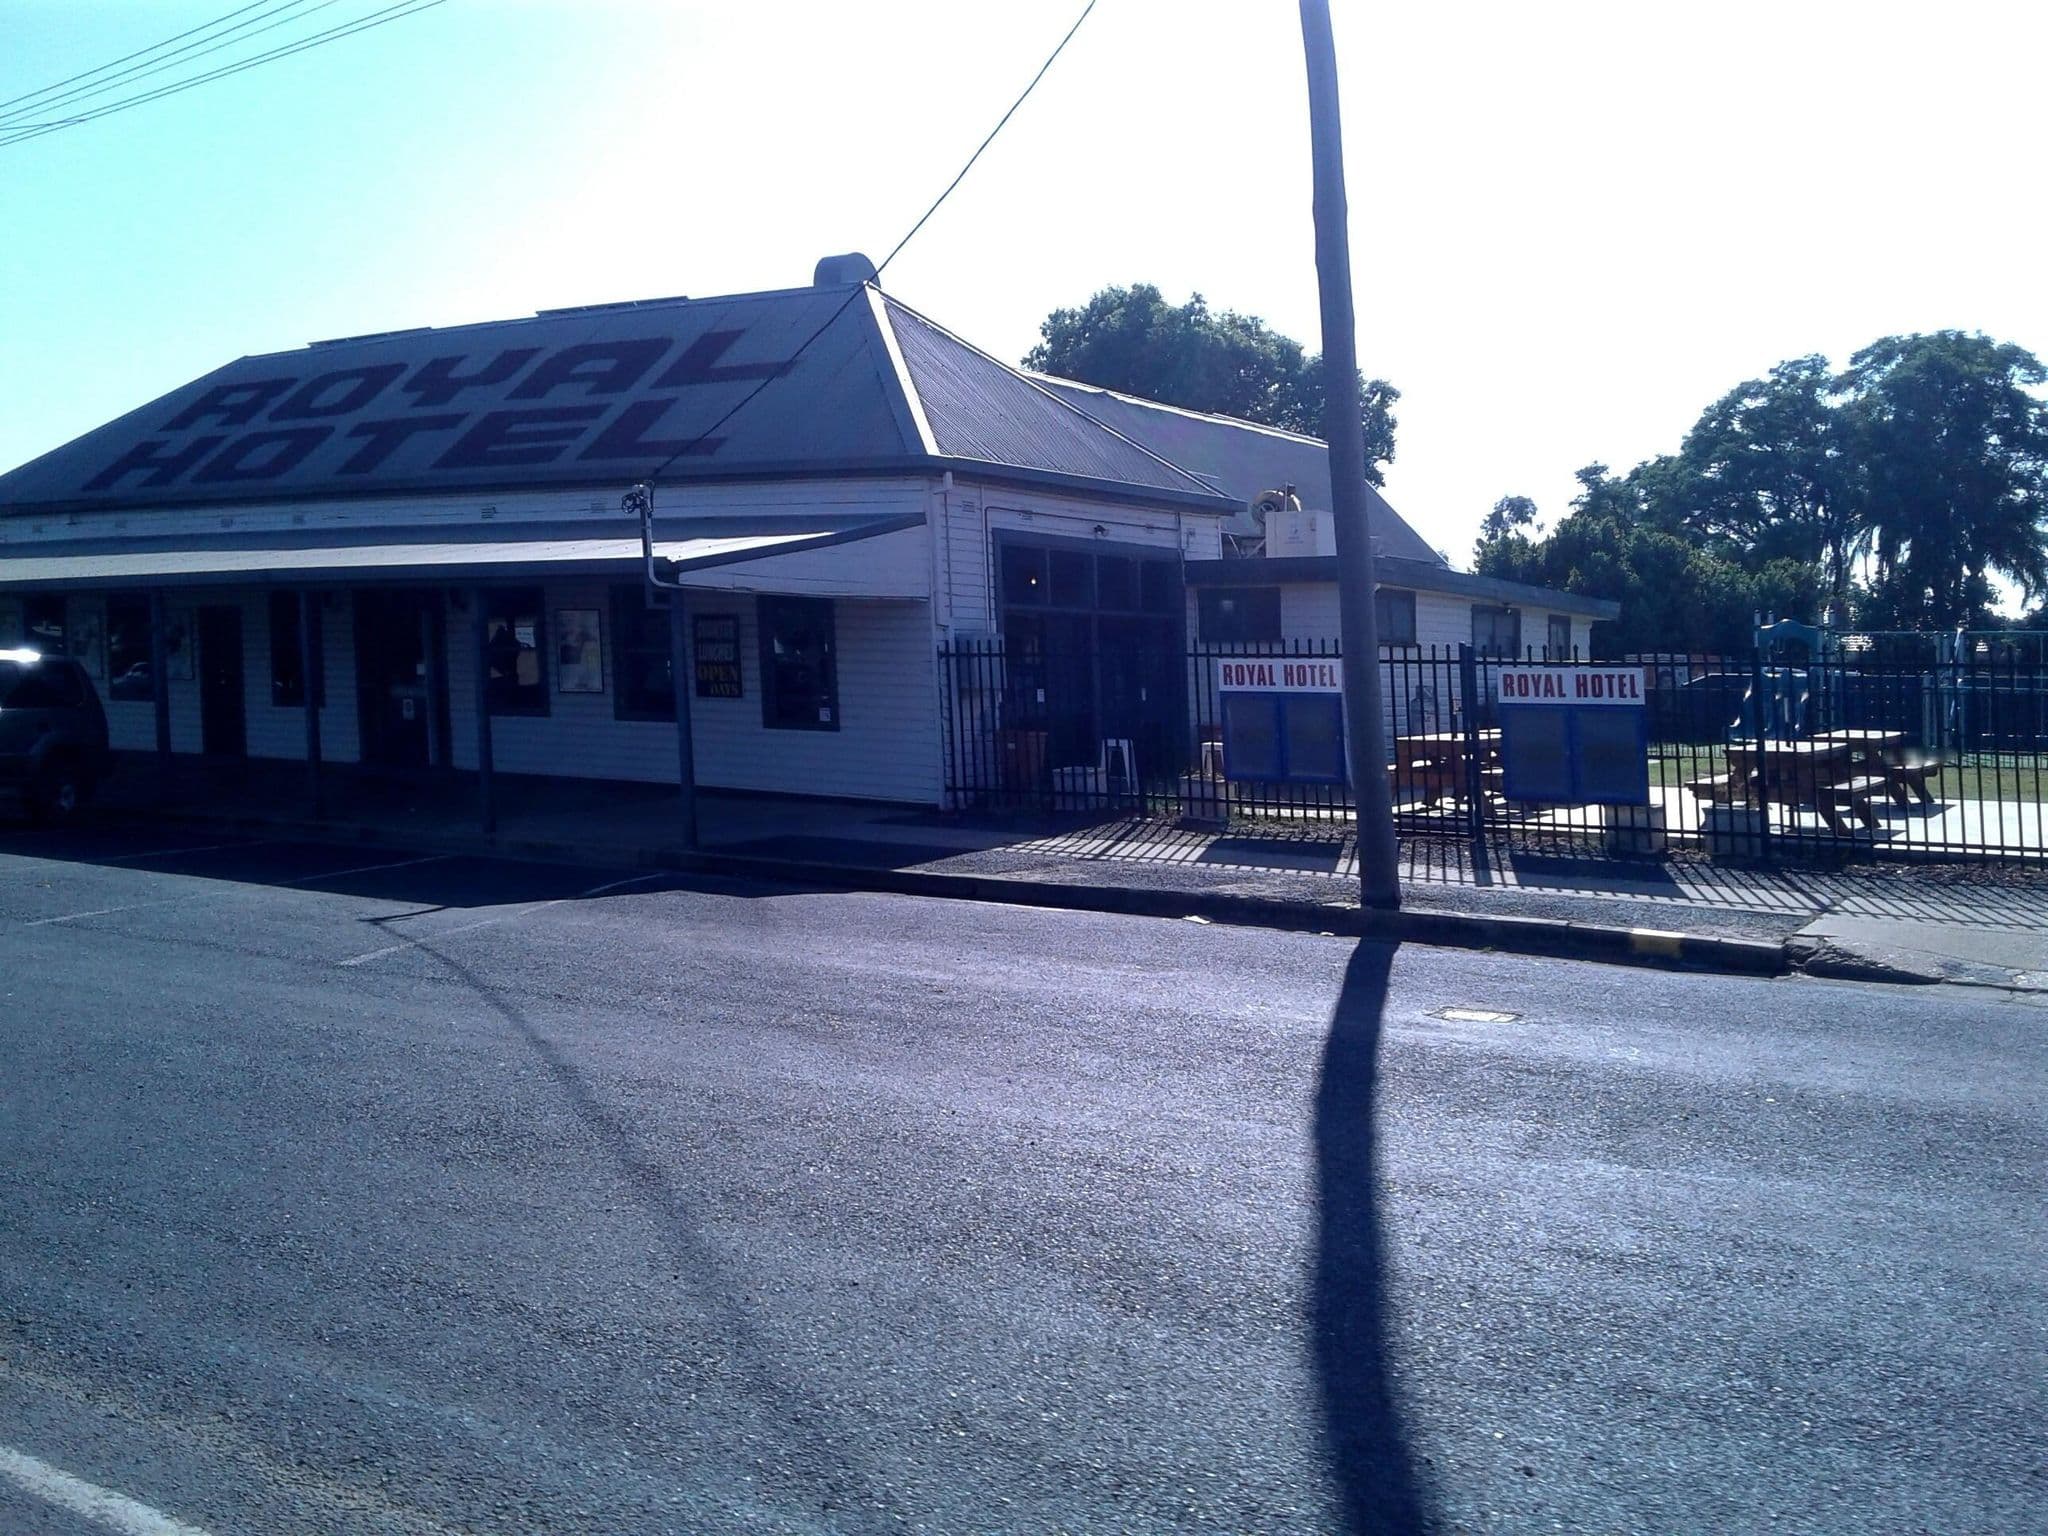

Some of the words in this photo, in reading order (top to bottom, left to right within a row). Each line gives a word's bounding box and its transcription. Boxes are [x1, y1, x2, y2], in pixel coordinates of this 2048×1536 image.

[157, 328, 799, 432] ROYAL
[80, 397, 728, 492] HOTEL
[697, 664, 738, 681] OPEN
[1223, 664, 1276, 686] ROYAL
[1283, 664, 1337, 687] HOTEL
[709, 683, 739, 696] DAYS
[1502, 673, 1567, 697] ROYAL
[1575, 674, 1639, 698] HOTEL
